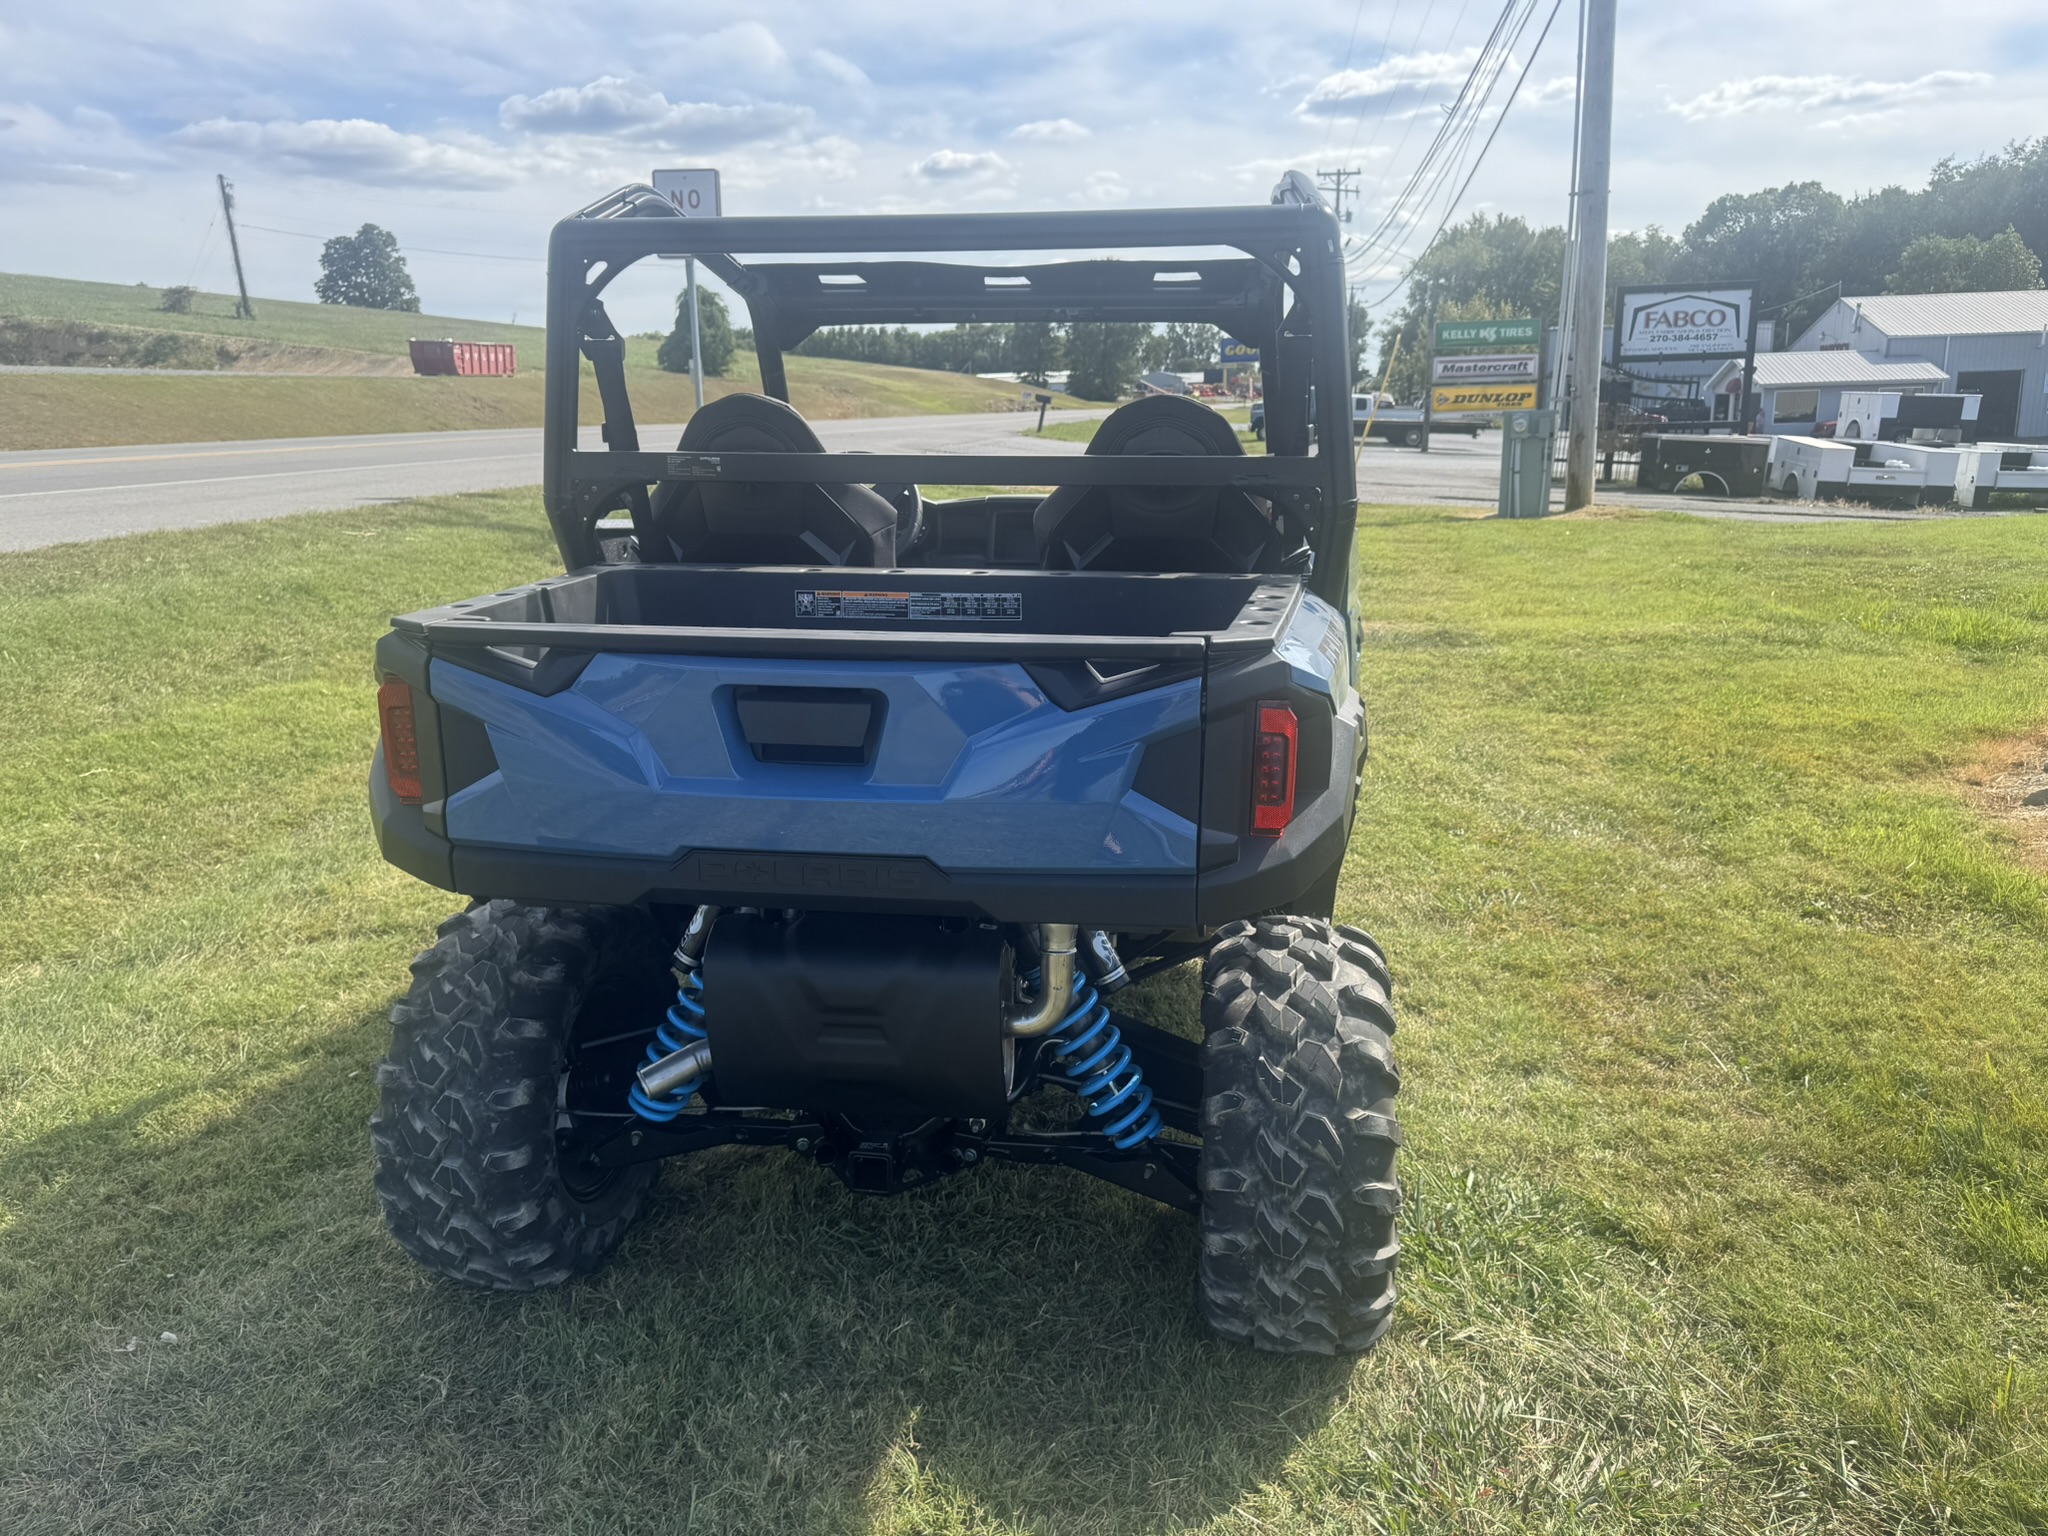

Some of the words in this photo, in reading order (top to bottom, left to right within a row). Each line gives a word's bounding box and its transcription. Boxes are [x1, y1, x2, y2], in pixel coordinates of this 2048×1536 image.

[671, 189, 701, 209] NO
[1643, 309, 1727, 329] FABCO
[1442, 329, 1477, 340] KELLY
[1500, 327, 1533, 337] TIRES
[1649, 333, 1718, 342] 270-384-4657
[1442, 362, 1528, 373] Mastercraft
[1451, 393, 1532, 404] DUNLOP
[697, 858, 922, 890] POLARIS
